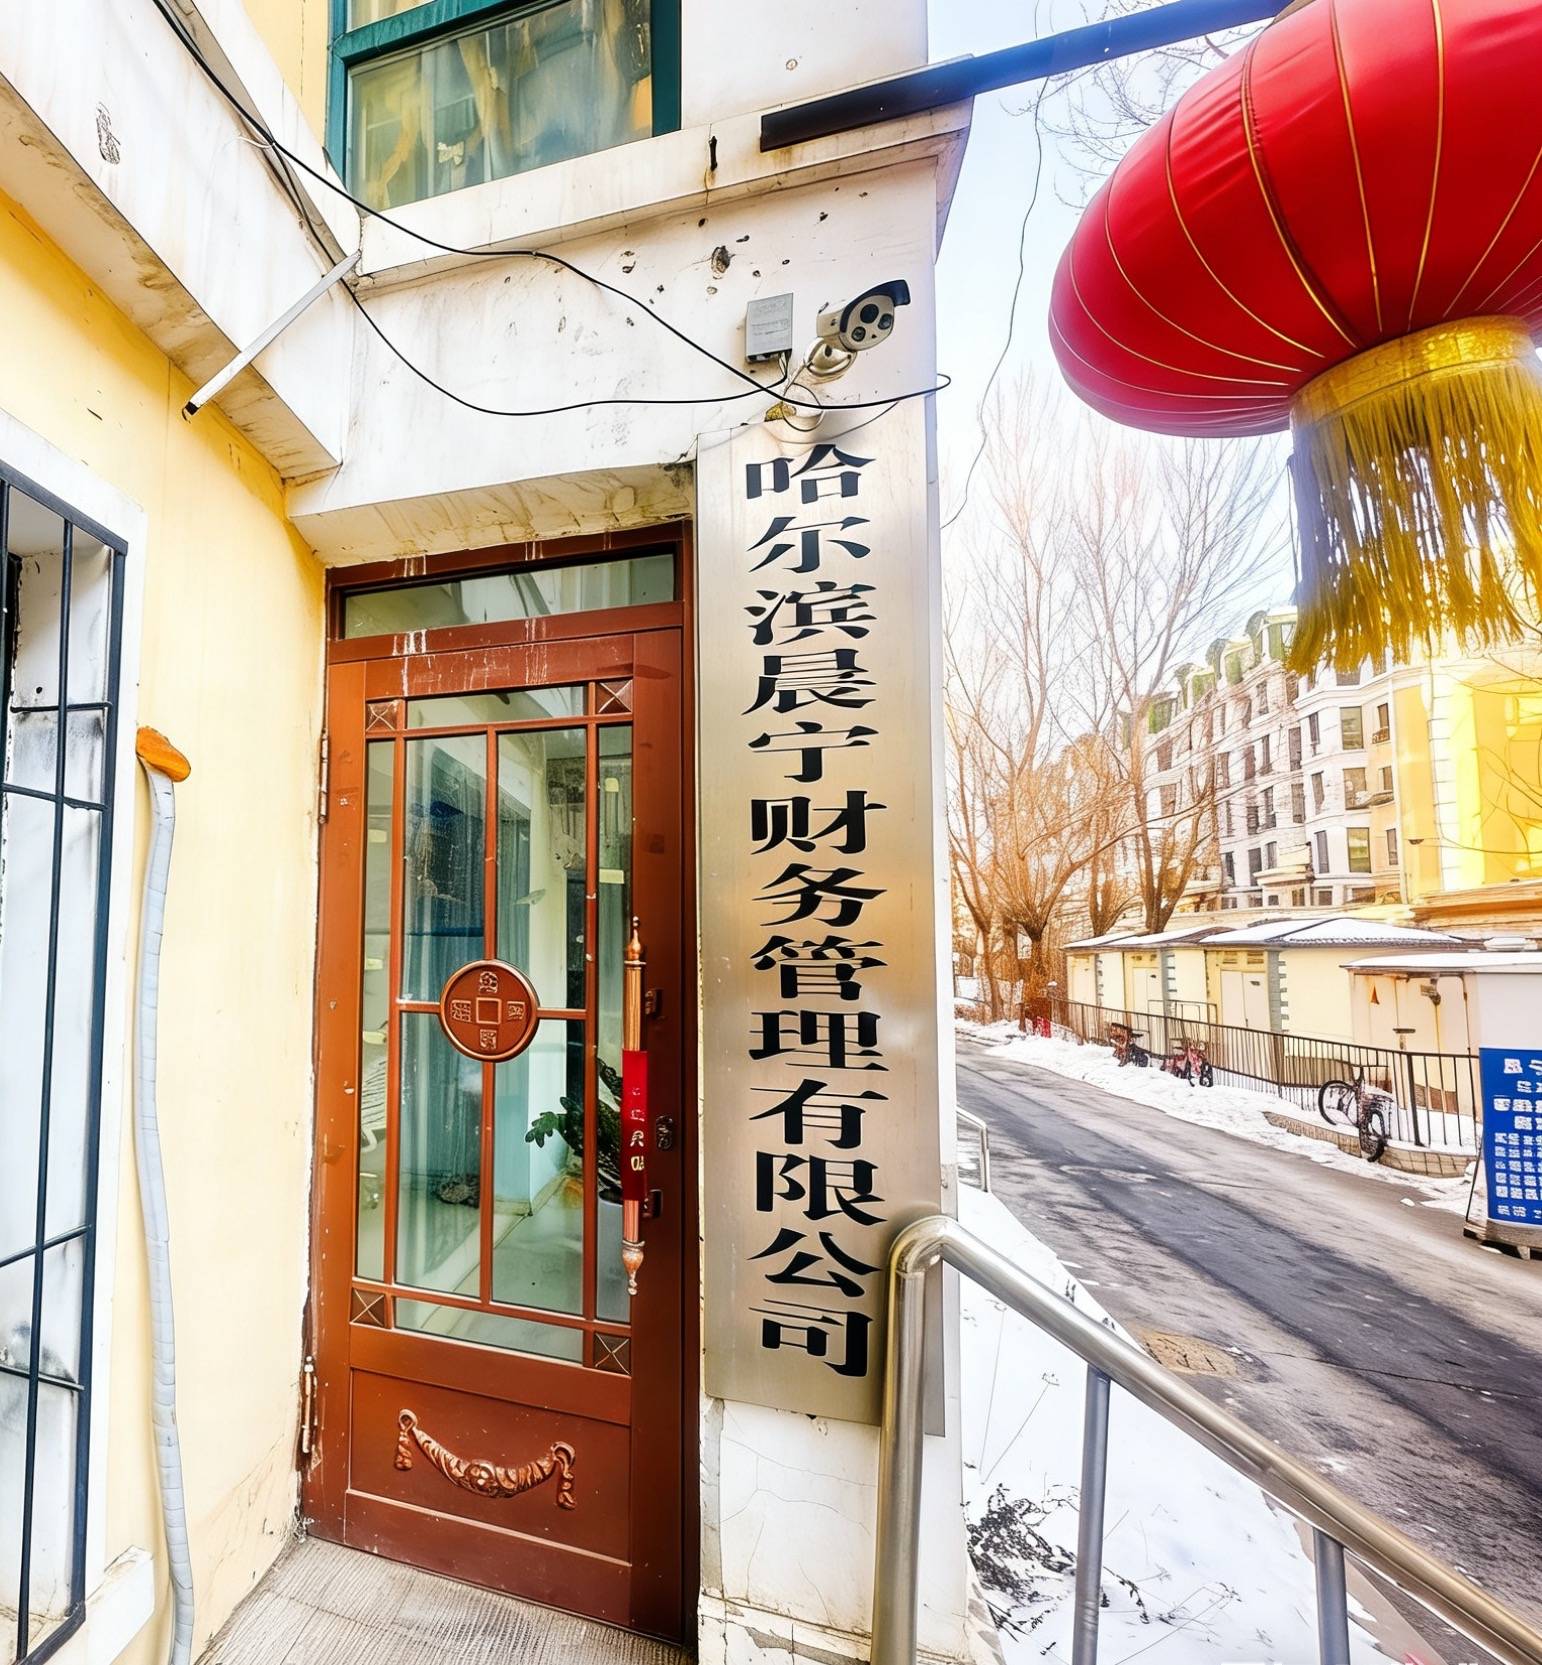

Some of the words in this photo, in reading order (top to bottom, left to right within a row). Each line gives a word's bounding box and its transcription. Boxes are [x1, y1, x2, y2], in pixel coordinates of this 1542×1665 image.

[742, 443, 889, 1378] 哈尔滨晨宁财务管理有限公司
